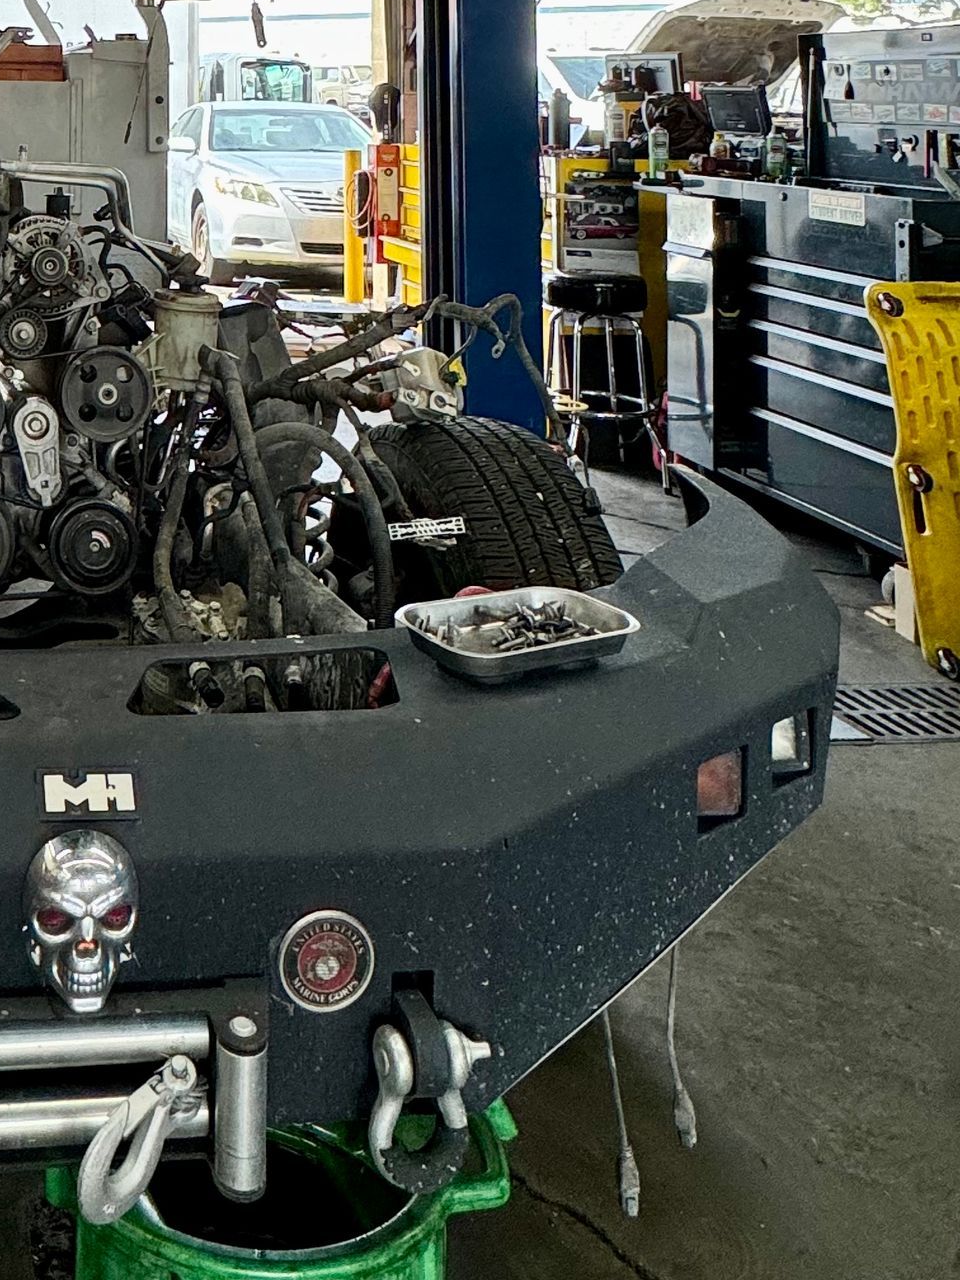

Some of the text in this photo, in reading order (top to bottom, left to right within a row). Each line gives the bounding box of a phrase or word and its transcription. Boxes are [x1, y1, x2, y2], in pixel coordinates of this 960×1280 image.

[292, 923, 365, 955] UNITED STATES
[292, 976, 359, 1003] MARINE CORPS
